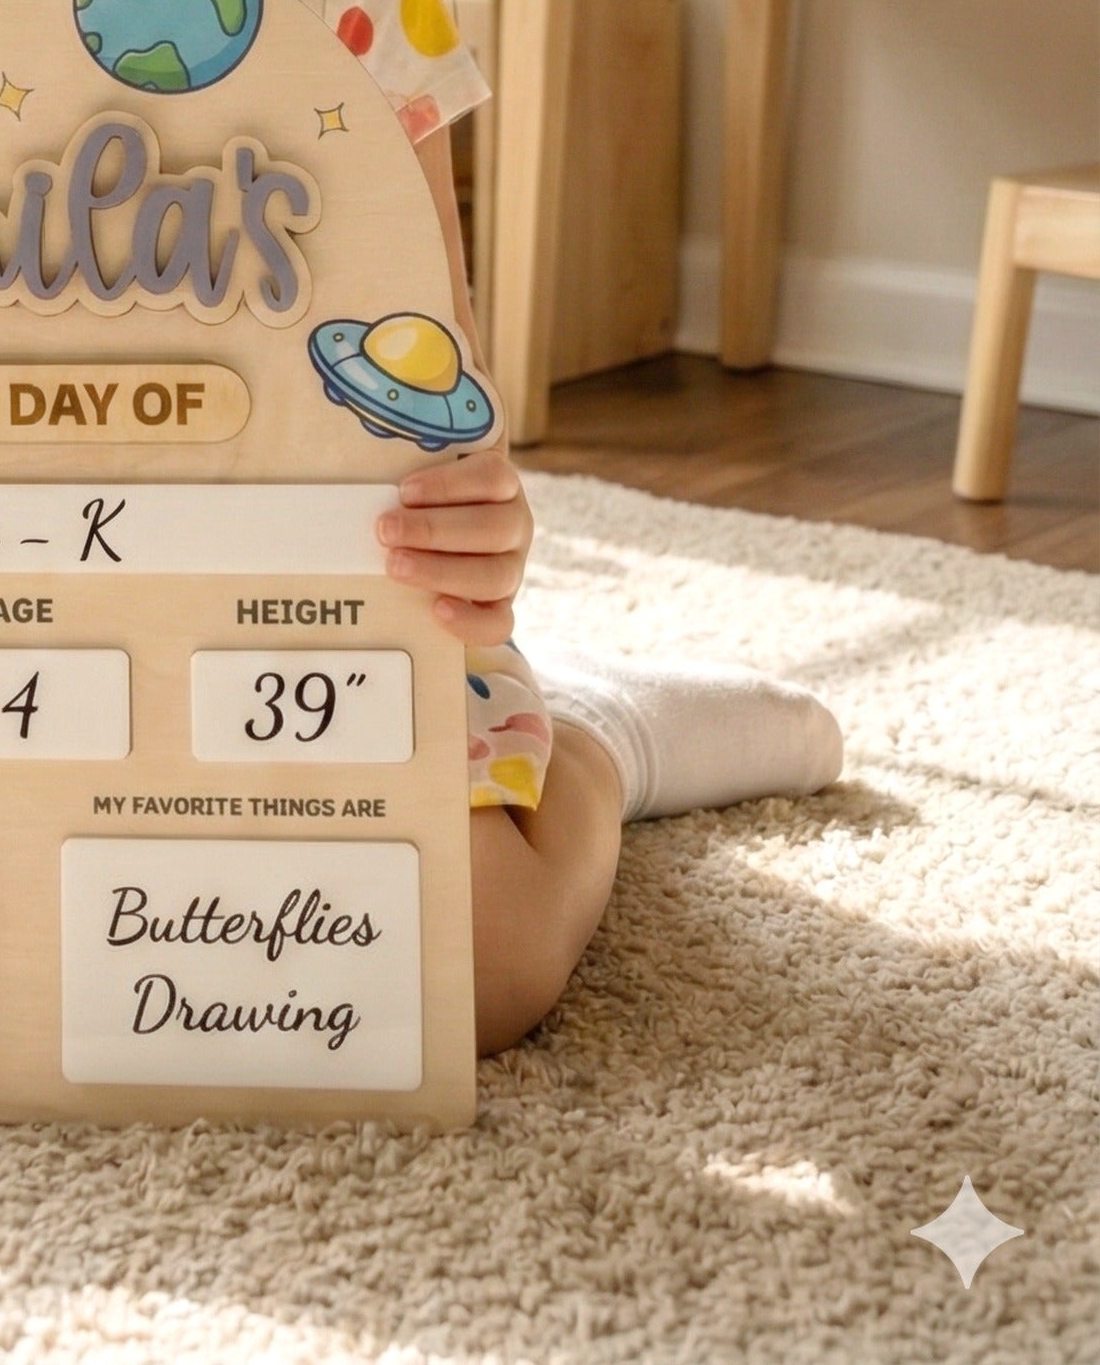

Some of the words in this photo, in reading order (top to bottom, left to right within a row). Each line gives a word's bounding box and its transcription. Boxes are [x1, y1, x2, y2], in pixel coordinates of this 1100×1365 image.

[9, 383, 119, 426] DAY
[132, 382, 205, 426] OF
[79, 498, 127, 563] K
[236, 598, 365, 626] HEIGHT
[1, 671, 40, 739] 4
[93, 796, 127, 815] MY
[132, 796, 243, 816] FAVORITE
[247, 797, 336, 817] THINGS
[341, 798, 386, 818] ARE
[106, 886, 382, 963] Butterflies
[132, 974, 361, 1051] Drawing
